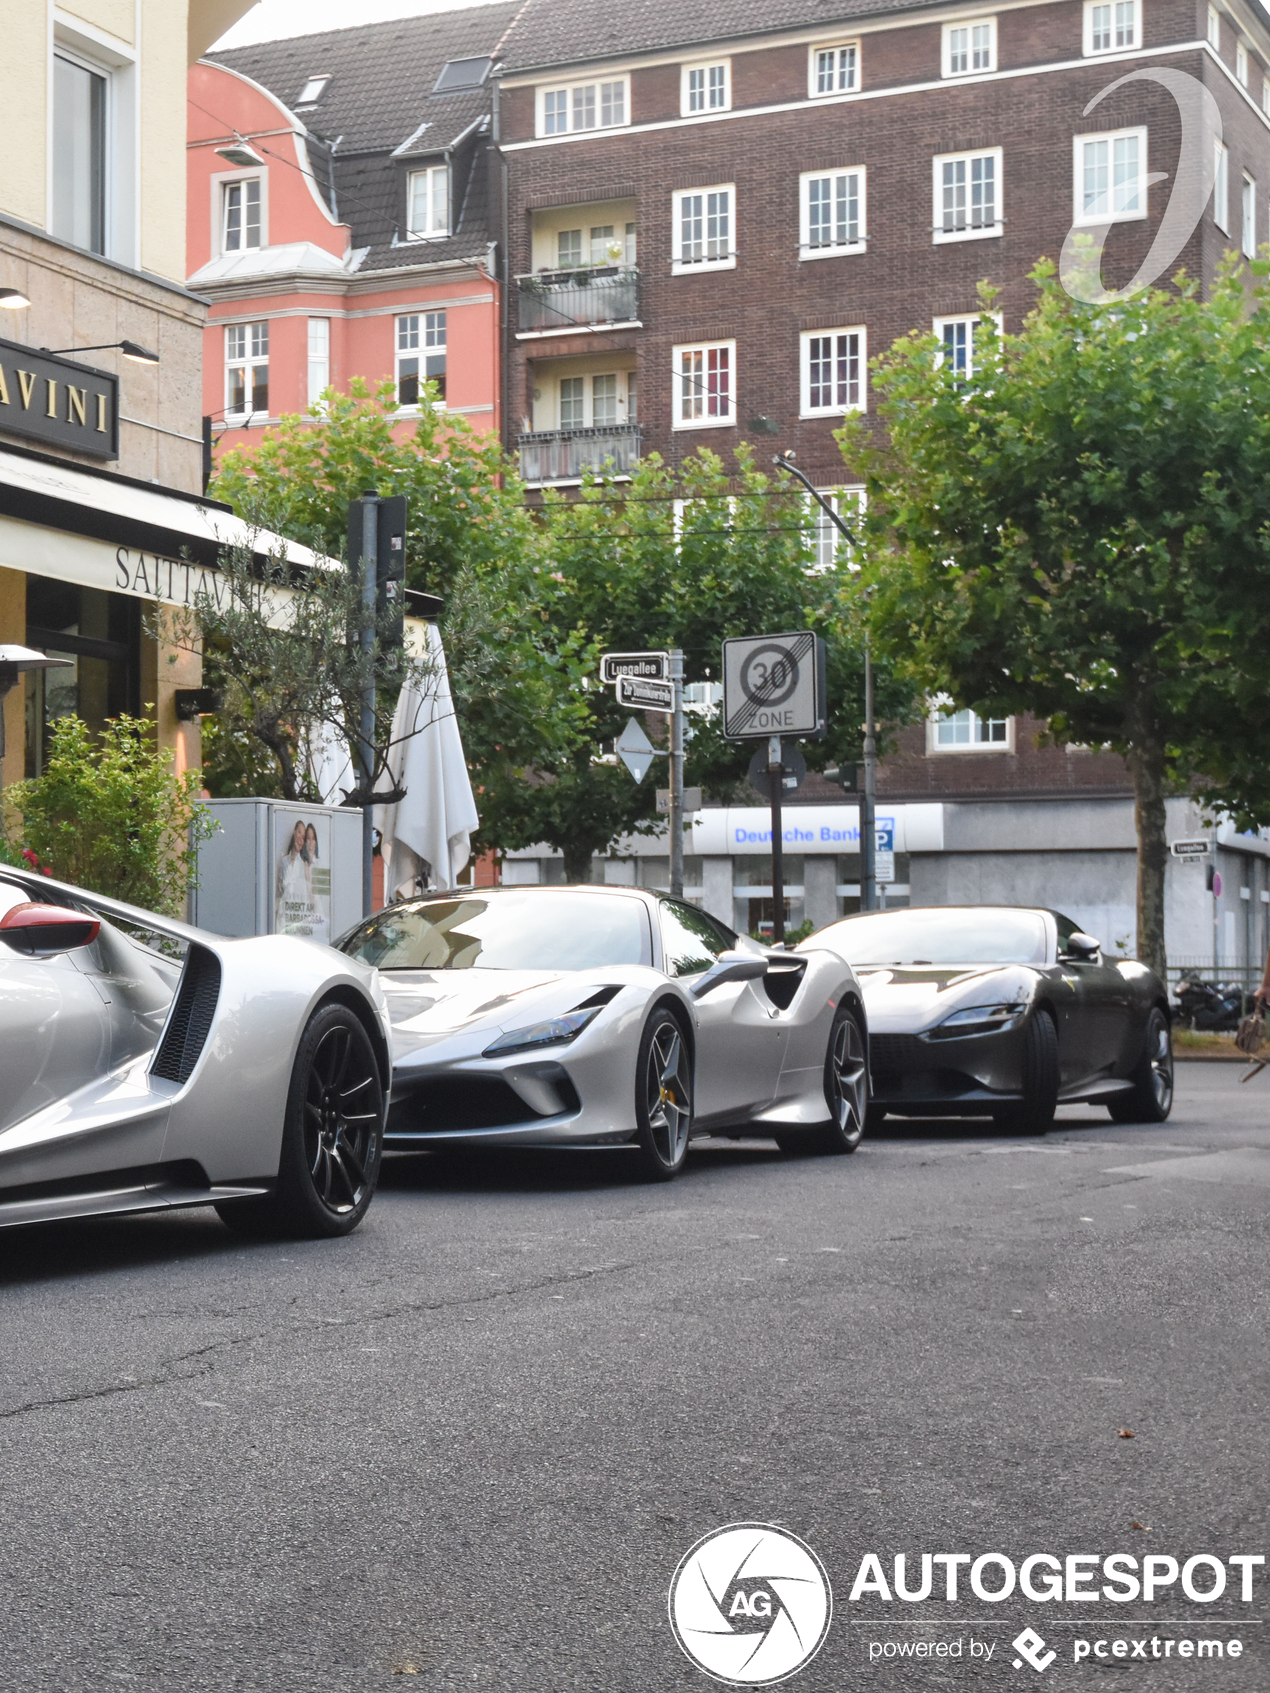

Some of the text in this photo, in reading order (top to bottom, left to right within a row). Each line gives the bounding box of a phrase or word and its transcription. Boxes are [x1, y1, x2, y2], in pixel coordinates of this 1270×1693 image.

[611, 661, 657, 676] Luegallee
[753, 661, 786, 690] 30
[749, 710, 794, 729] ZONE
[735, 826, 861, 843] Deutche Bank
[875, 831, 888, 851] P
[285, 901, 305, 912] DIREKT
